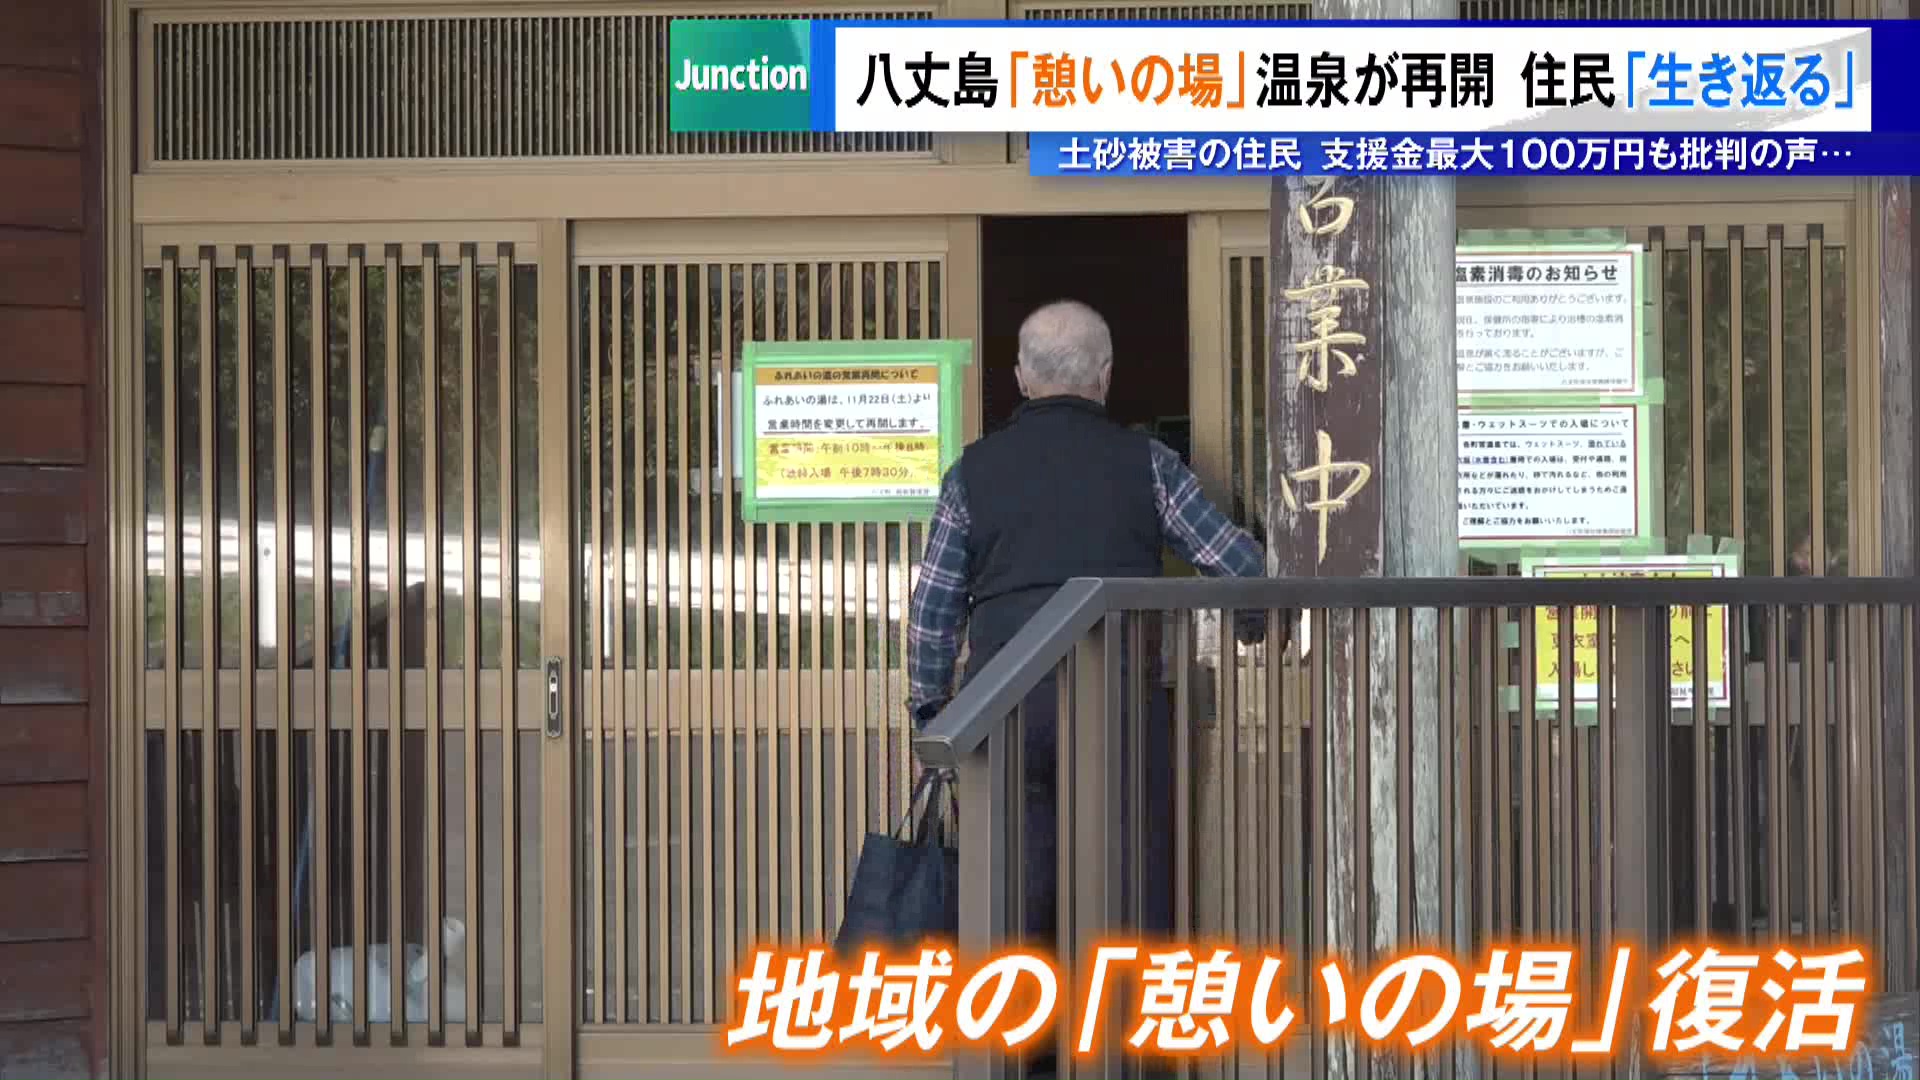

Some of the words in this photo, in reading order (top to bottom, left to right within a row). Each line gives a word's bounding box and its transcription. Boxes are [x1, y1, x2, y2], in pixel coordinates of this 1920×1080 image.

[1457, 418, 1630, 430] 着・ウェットスーツでの入場について
